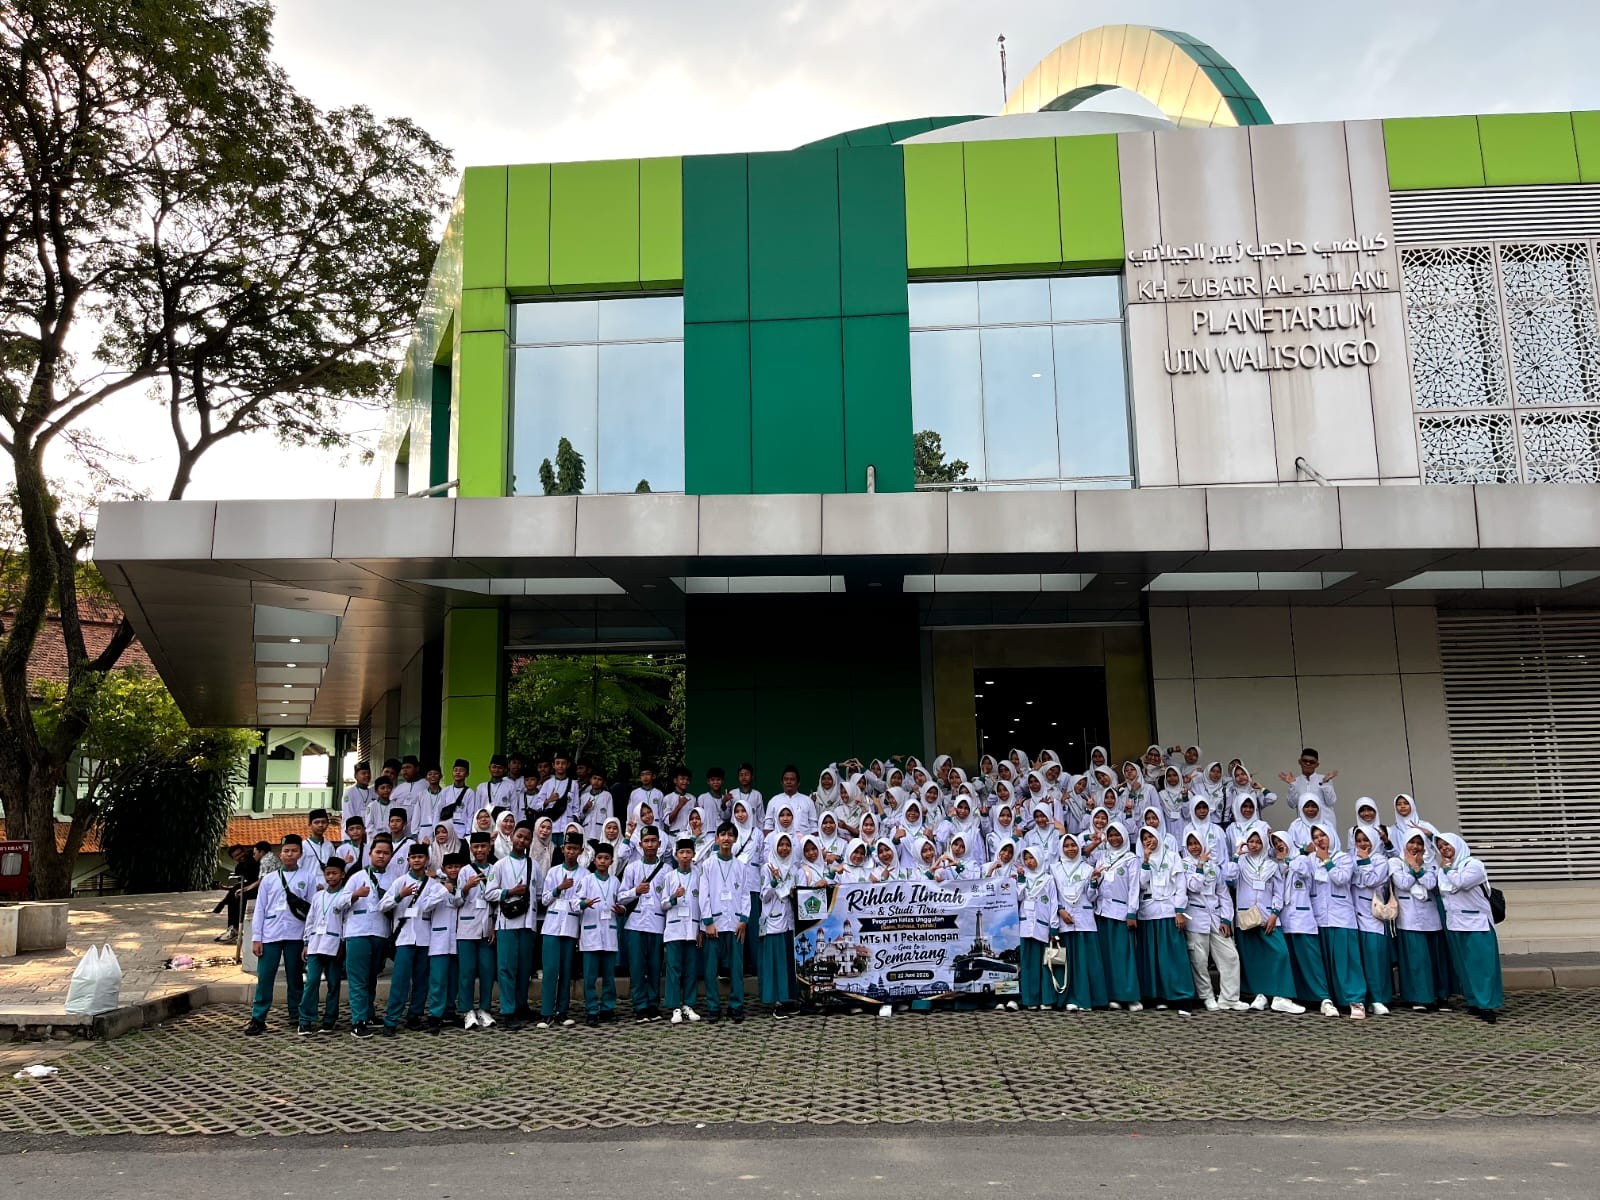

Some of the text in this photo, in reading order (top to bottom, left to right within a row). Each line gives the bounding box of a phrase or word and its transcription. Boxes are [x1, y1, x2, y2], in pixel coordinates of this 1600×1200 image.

[1127, 232, 1389, 268] كياهي حاجي زبير الجيلاني
[1264, 270, 1390, 295] AL-JAILANI
[1191, 301, 1377, 335] PLANETARIUM
[1163, 340, 1381, 375] UIN WALISONGO
[846, 886, 905, 912] Rihlah
[908, 884, 965, 905] Ilmiah
[871, 918, 898, 926] Program
[915, 916, 945, 924] Unggulan
[877, 903, 937, 917] & Studi Tiru
[859, 932, 959, 944] MTs N 1 Pekalongan
[897, 943, 912, 951] Goes
[874, 948, 947, 969] Semarang
